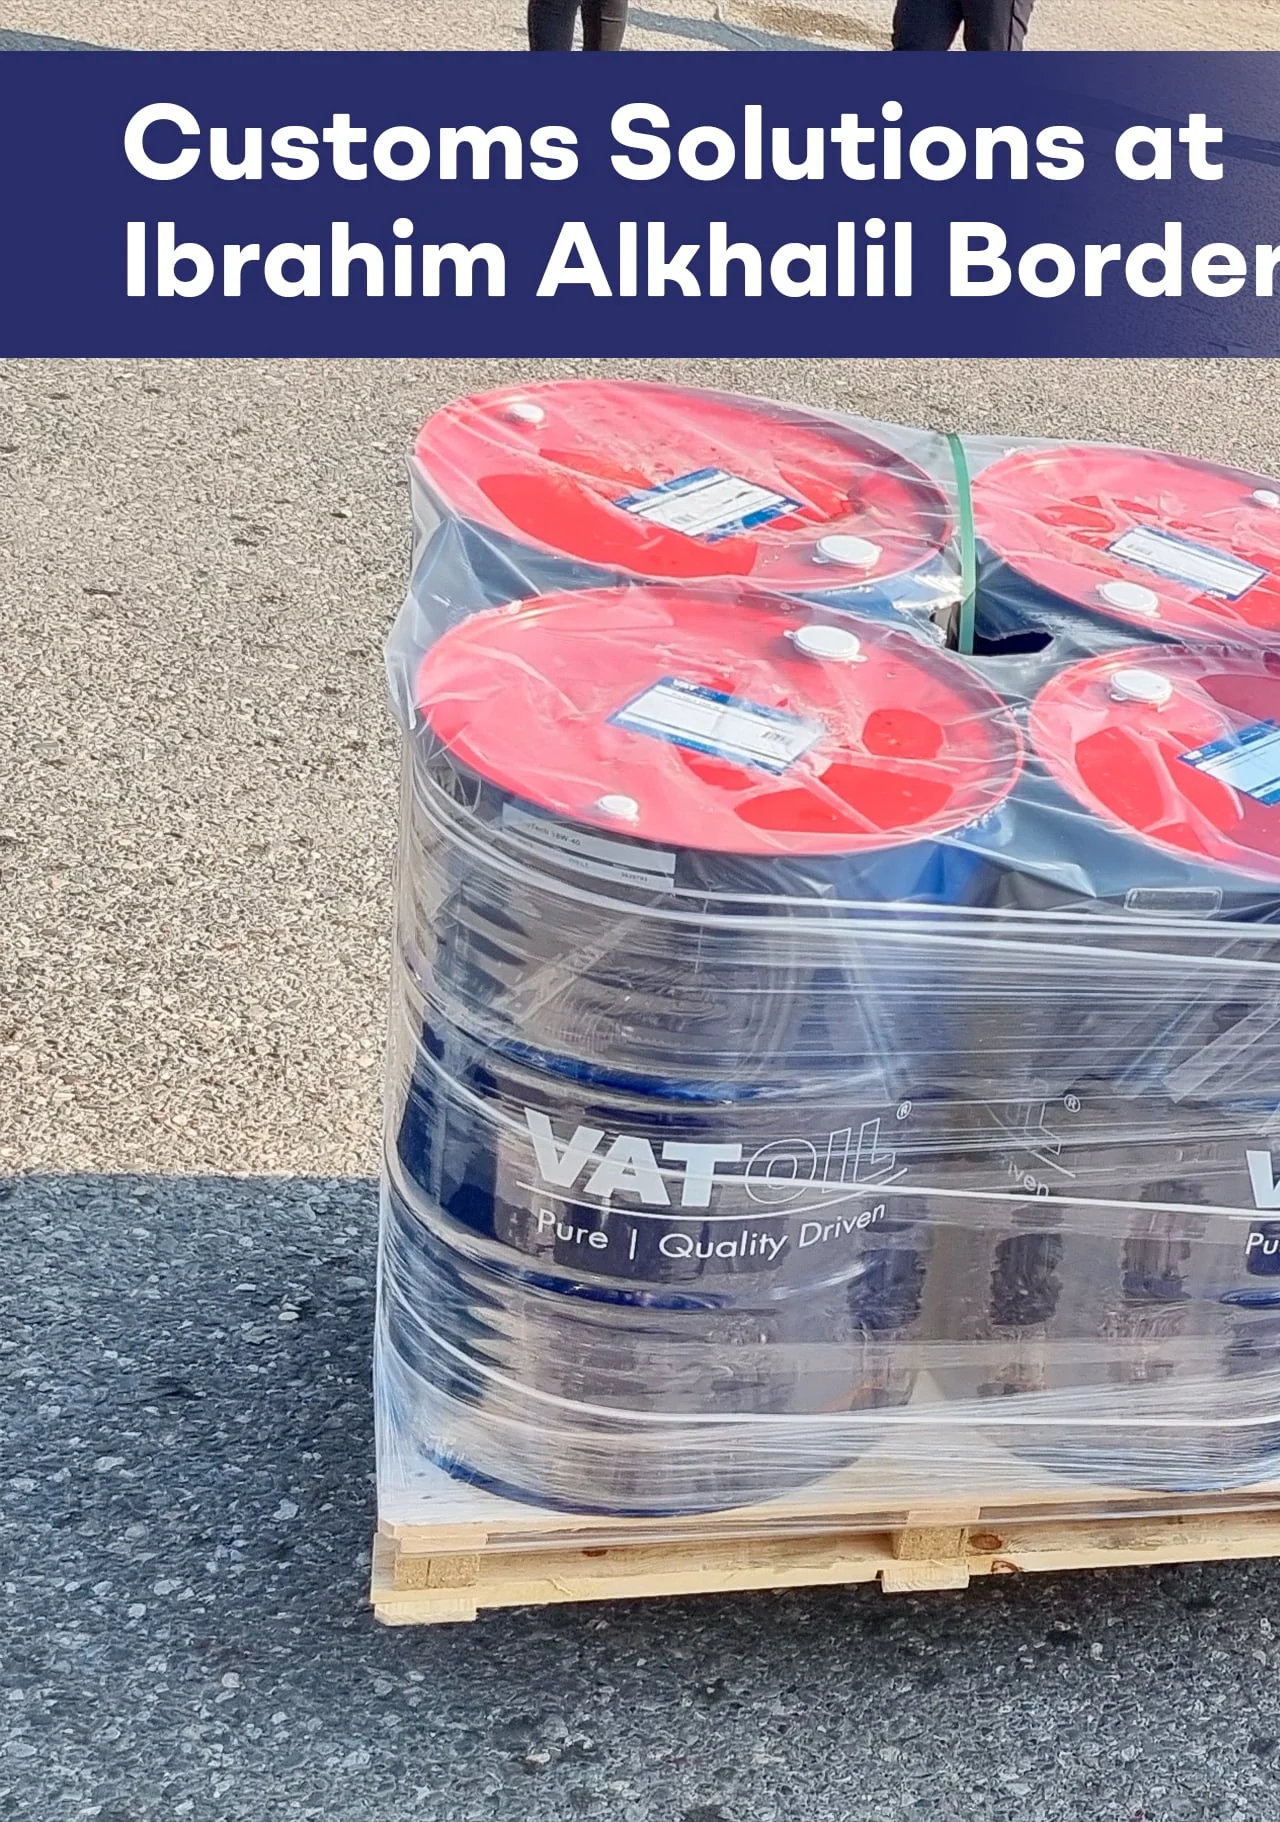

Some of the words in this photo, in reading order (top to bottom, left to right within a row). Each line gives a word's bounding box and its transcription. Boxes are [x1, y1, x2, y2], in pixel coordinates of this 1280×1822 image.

[535, 1206, 610, 1251] Pure
[658, 1231, 788, 1263] Quality
[797, 1201, 887, 1250] Driven
